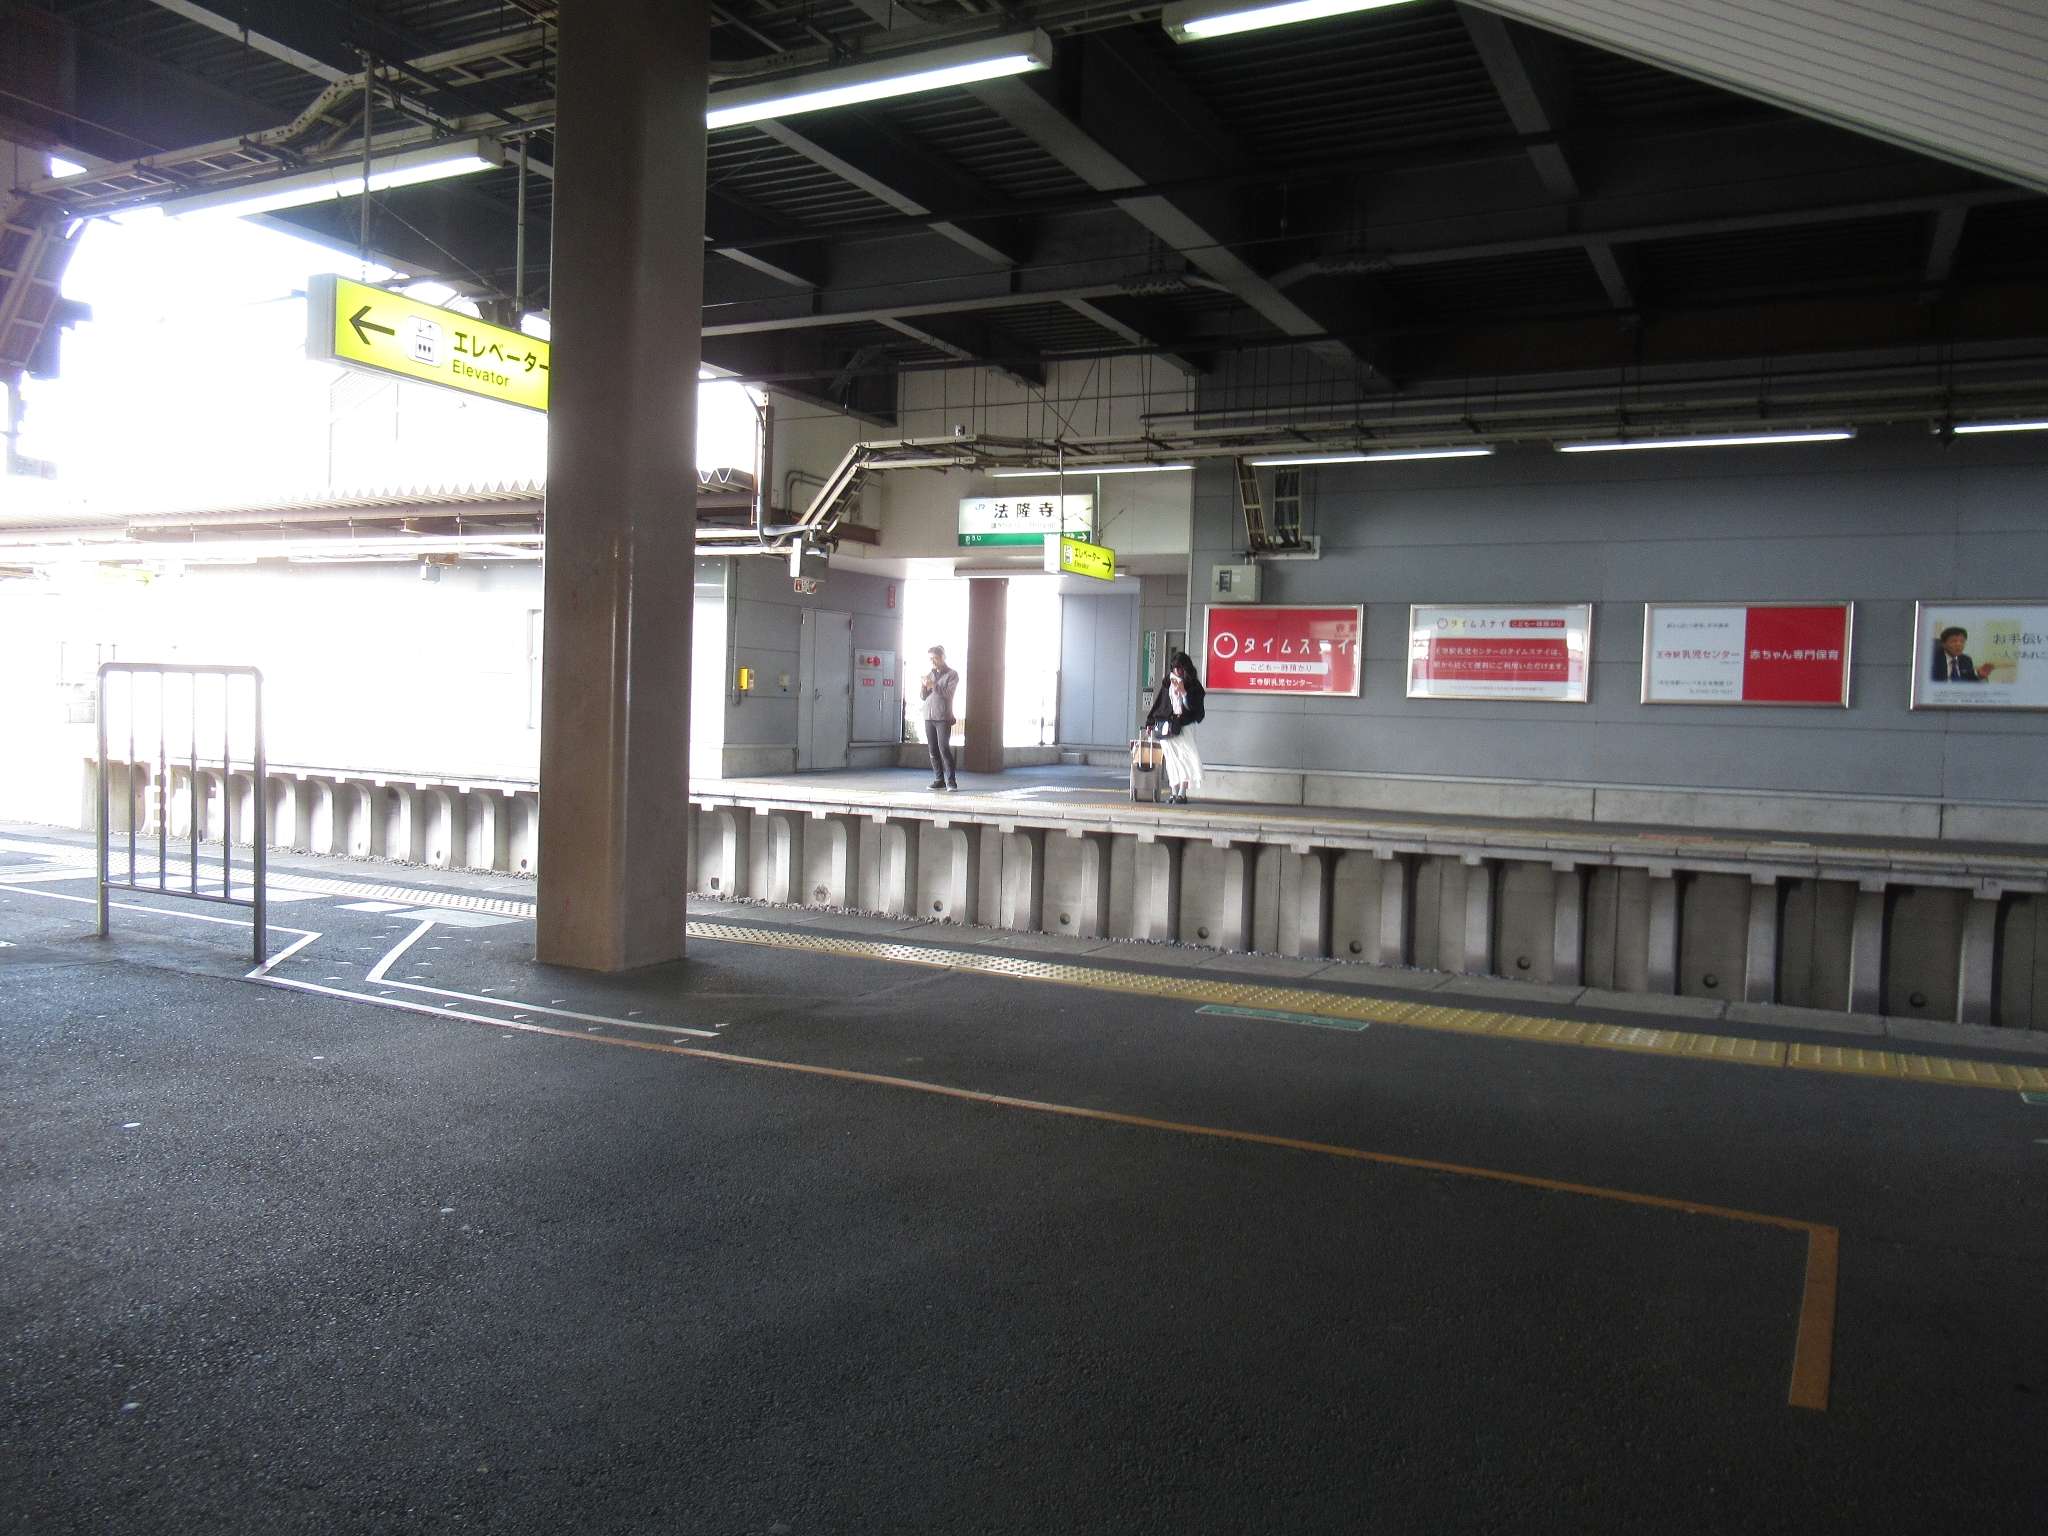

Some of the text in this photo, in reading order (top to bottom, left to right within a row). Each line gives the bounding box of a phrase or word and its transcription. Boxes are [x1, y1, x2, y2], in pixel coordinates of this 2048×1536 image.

[453, 331, 549, 373] エレベーター
[452, 359, 510, 387] Elevator
[994, 502, 1054, 519] 法隆寺
[1750, 648, 1840, 661] 赤ちゃん専門保育
